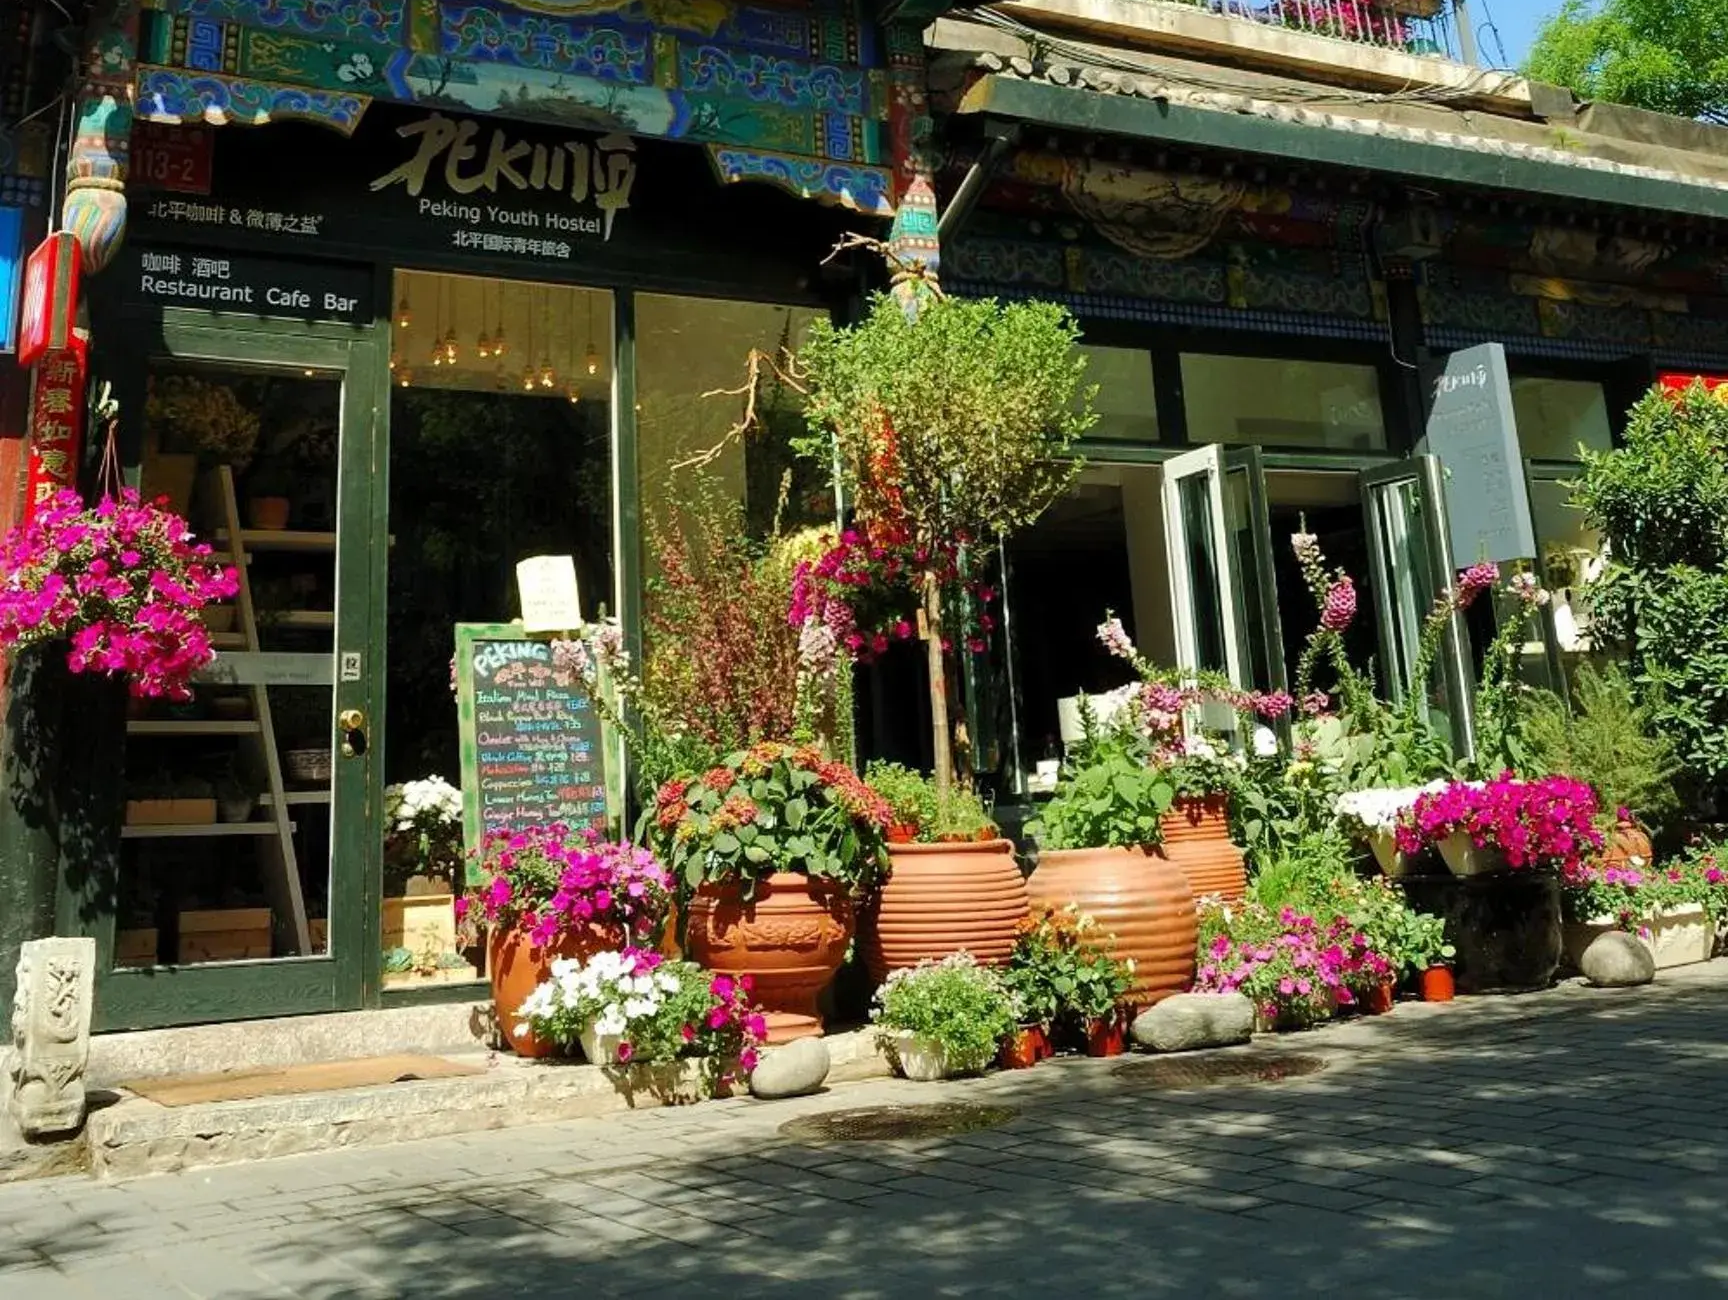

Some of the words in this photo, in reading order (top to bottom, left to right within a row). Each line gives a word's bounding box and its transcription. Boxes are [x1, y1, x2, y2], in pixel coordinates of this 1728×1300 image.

[134, 149, 195, 182] 113-2
[148, 200, 226, 224] 北平咖啡
[229, 208, 243, 225] &
[419, 198, 481, 223] Peking
[487, 206, 539, 227] Youth
[545, 213, 600, 233] Hostel
[141, 252, 182, 275] 咖啡
[192, 257, 230, 279] 酒吧
[141, 275, 254, 302] Restaurant
[266, 287, 311, 308] Cafe
[324, 293, 358, 312] Bar
[473, 641, 548, 677] PEKING
